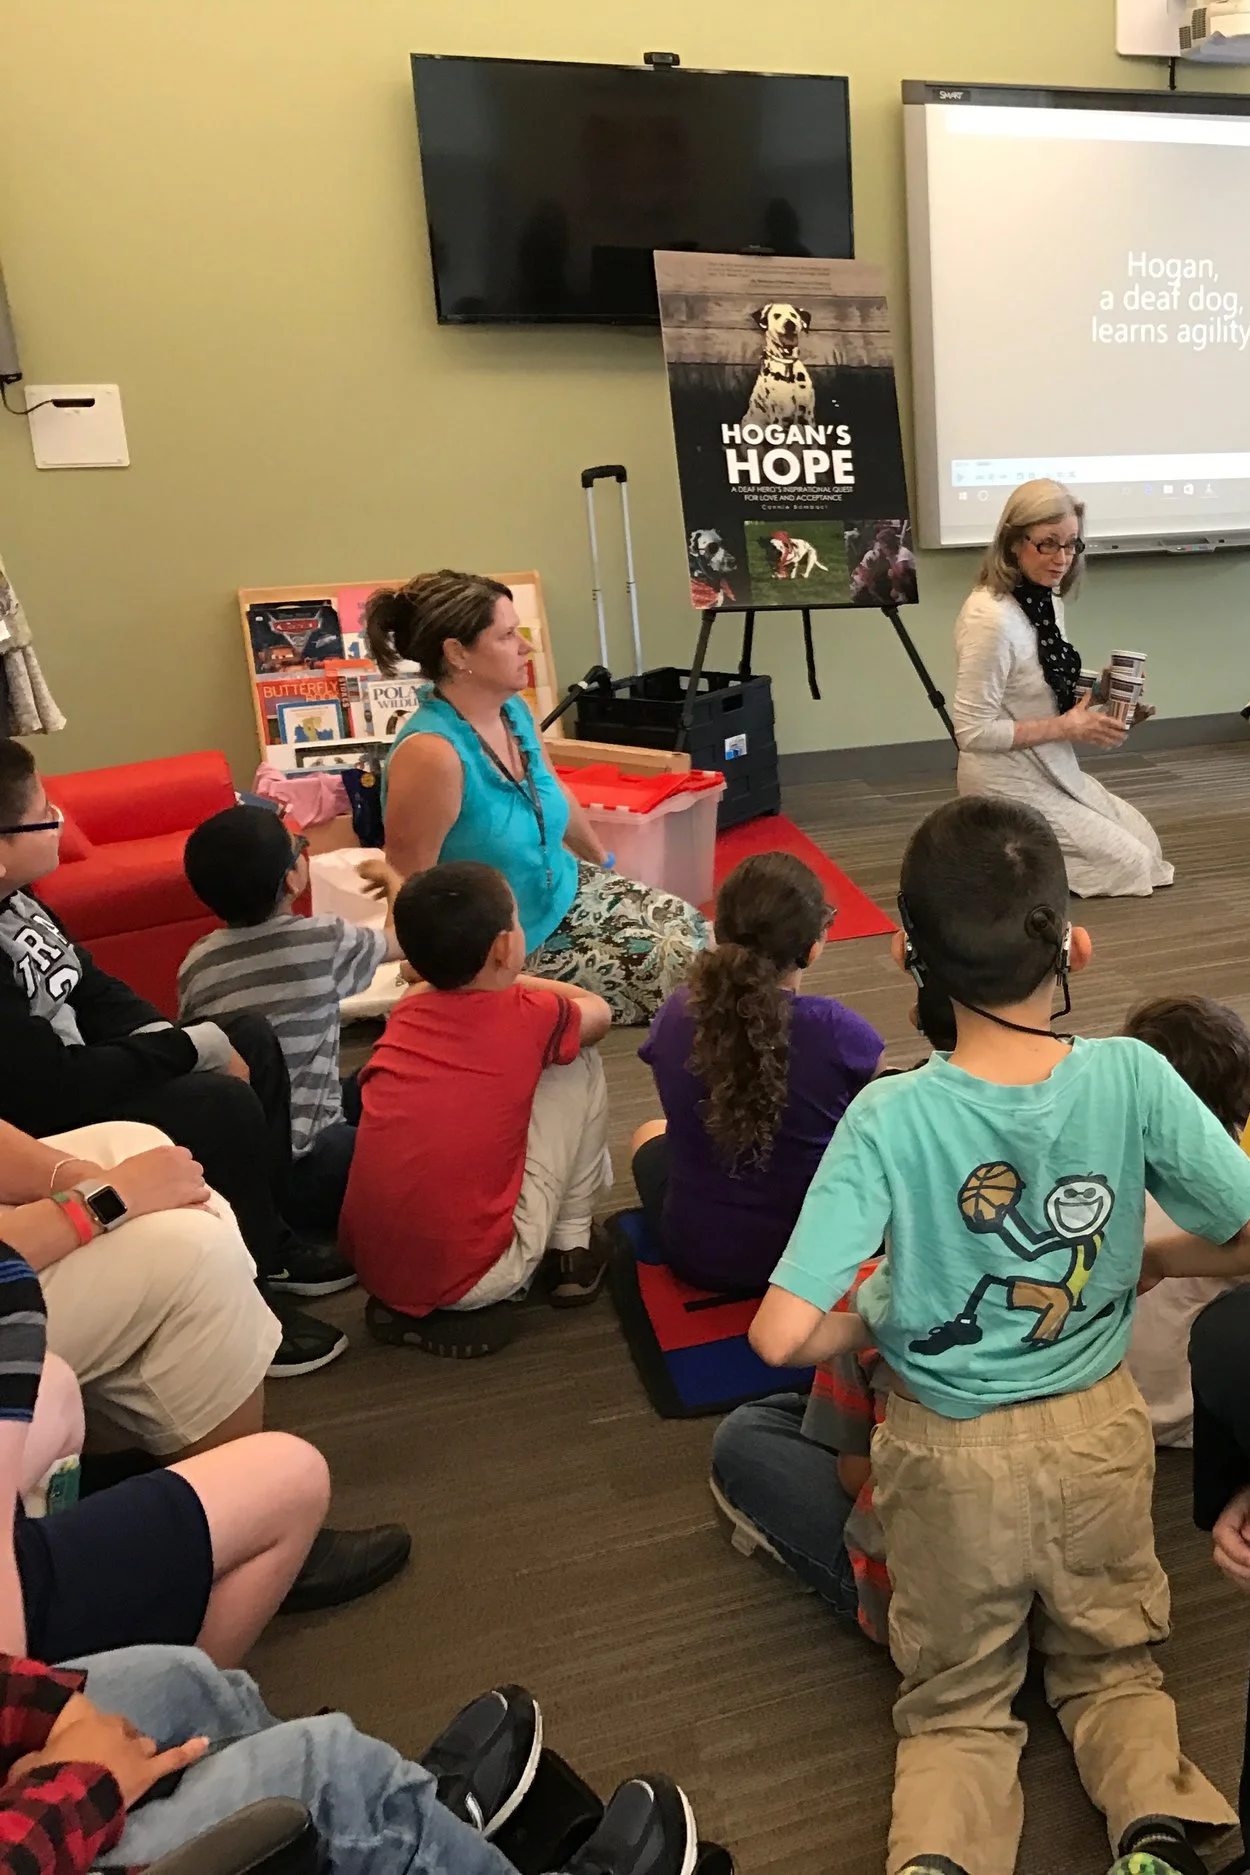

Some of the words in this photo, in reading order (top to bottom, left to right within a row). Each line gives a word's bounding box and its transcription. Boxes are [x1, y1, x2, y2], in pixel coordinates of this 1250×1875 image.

[939, 90, 964, 100] SMART
[1127, 251, 1219, 287] Hogan,
[1099, 290, 1114, 311] a
[1123, 283, 1181, 311] deaf
[1188, 284, 1244, 321] dog,
[1092, 316, 1168, 344] learns
[721, 423, 851, 446] HOGAN'S
[726, 448, 855, 485] HOPE
[263, 681, 338, 698] BUTTERFLY
[373, 685, 417, 700] POLA
[377, 698, 418, 709] WILDLI
